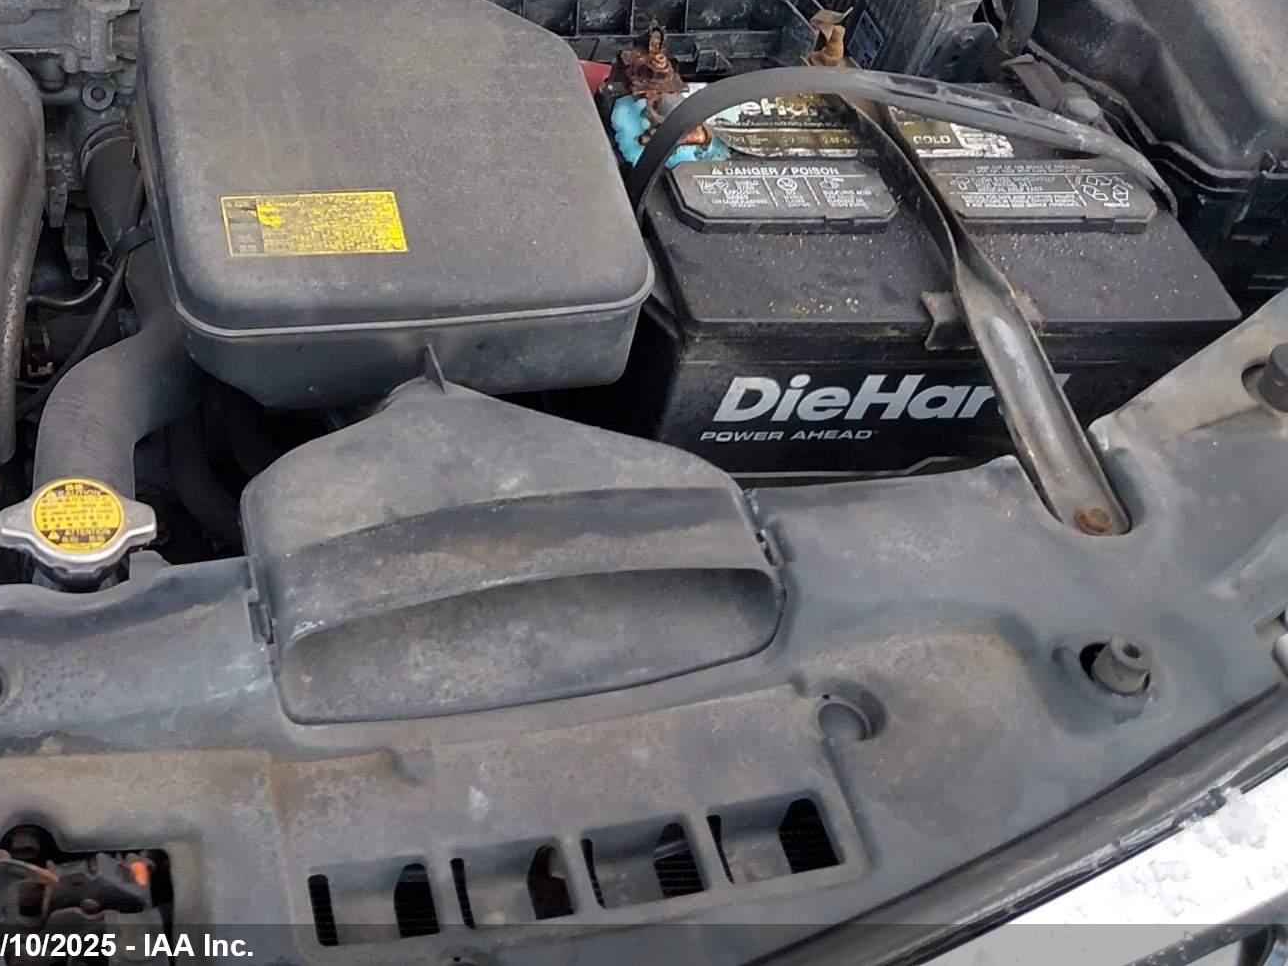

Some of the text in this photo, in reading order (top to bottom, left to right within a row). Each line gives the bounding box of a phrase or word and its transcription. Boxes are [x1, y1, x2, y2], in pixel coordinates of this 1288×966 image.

[724, 166, 779, 176] DANGER
[790, 166, 840, 176] POISON
[712, 372, 1070, 423] DieHar
[699, 429, 873, 443] POWER AHEAD
